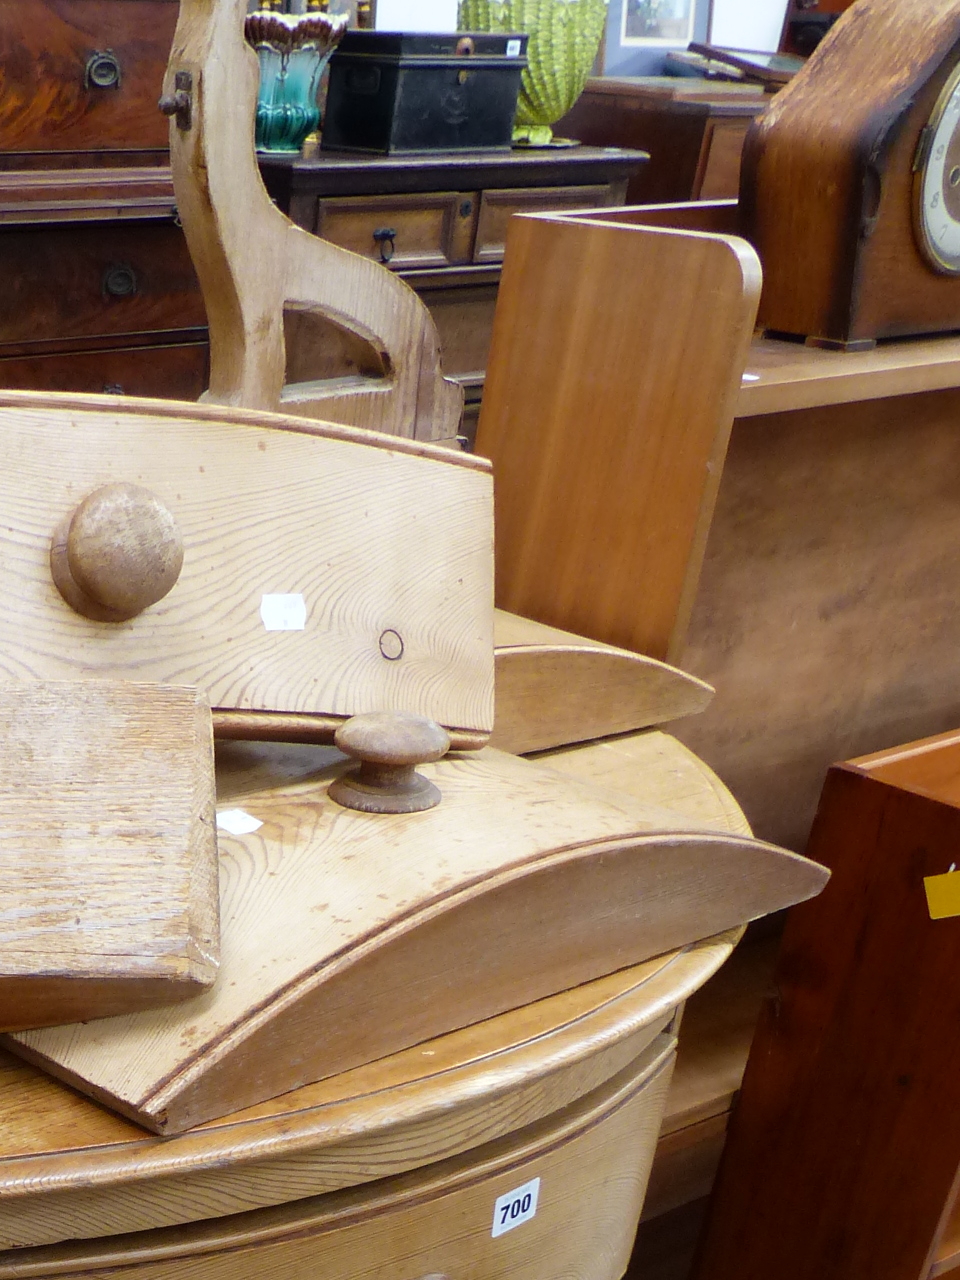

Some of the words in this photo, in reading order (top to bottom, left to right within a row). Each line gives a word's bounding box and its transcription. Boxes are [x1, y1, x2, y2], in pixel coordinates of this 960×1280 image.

[935, 144, 945, 161] 9
[930, 191, 940, 209] 8
[939, 224, 948, 240] 7
[500, 1193, 532, 1225] 700
